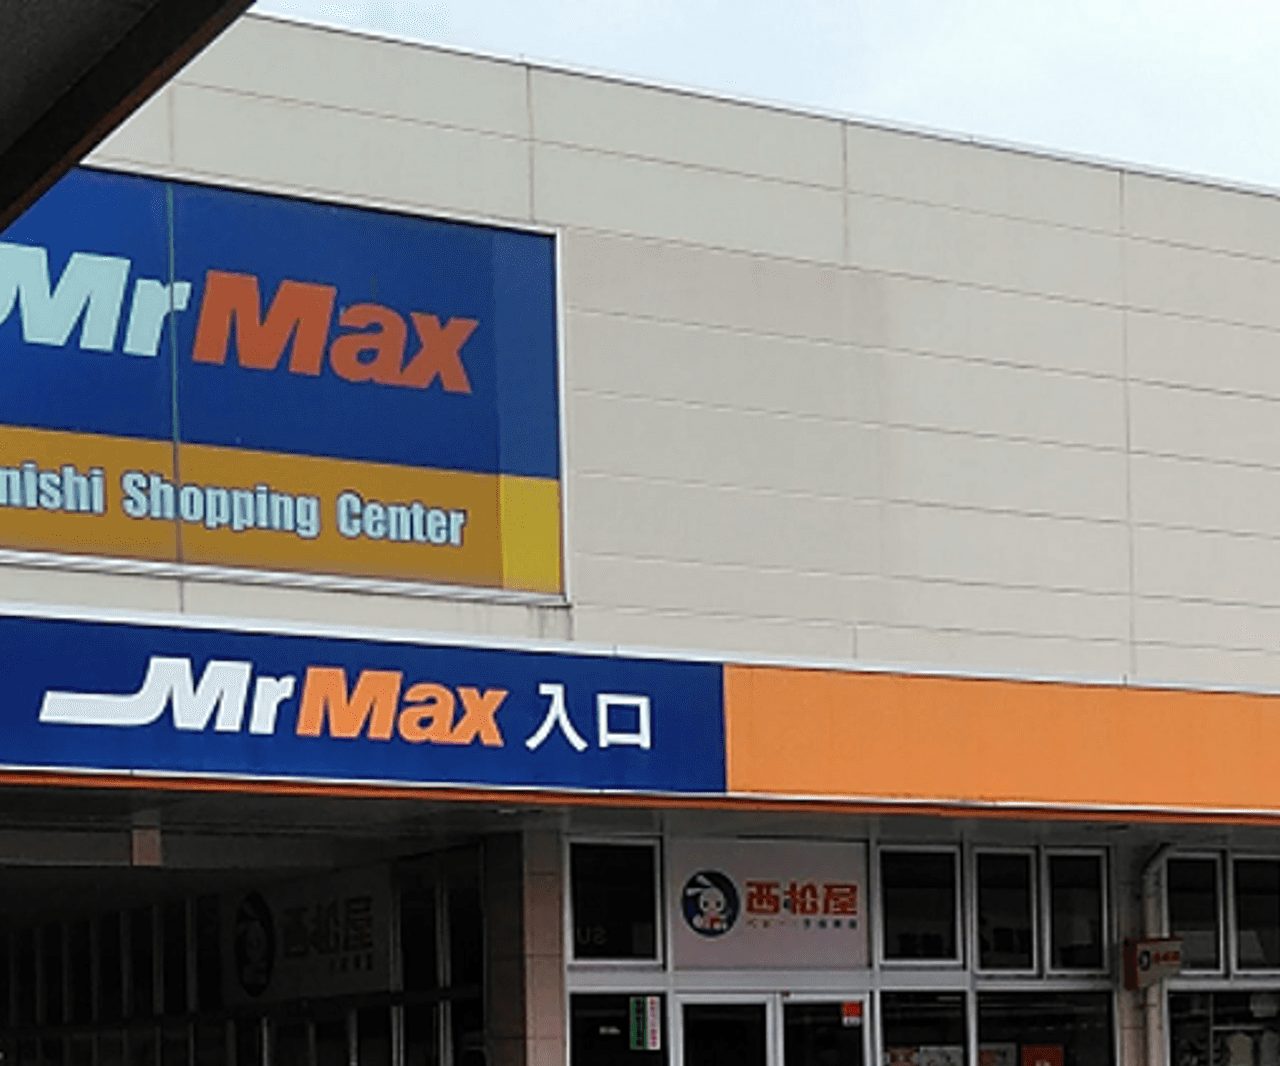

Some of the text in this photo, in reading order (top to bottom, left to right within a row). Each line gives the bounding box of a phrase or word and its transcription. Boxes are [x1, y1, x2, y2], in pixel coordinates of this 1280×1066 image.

[121, 471, 320, 538] Shopping
[336, 492, 467, 546] Center
[524, 683, 651, 751] 入口
[745, 880, 858, 915] 西松屋
